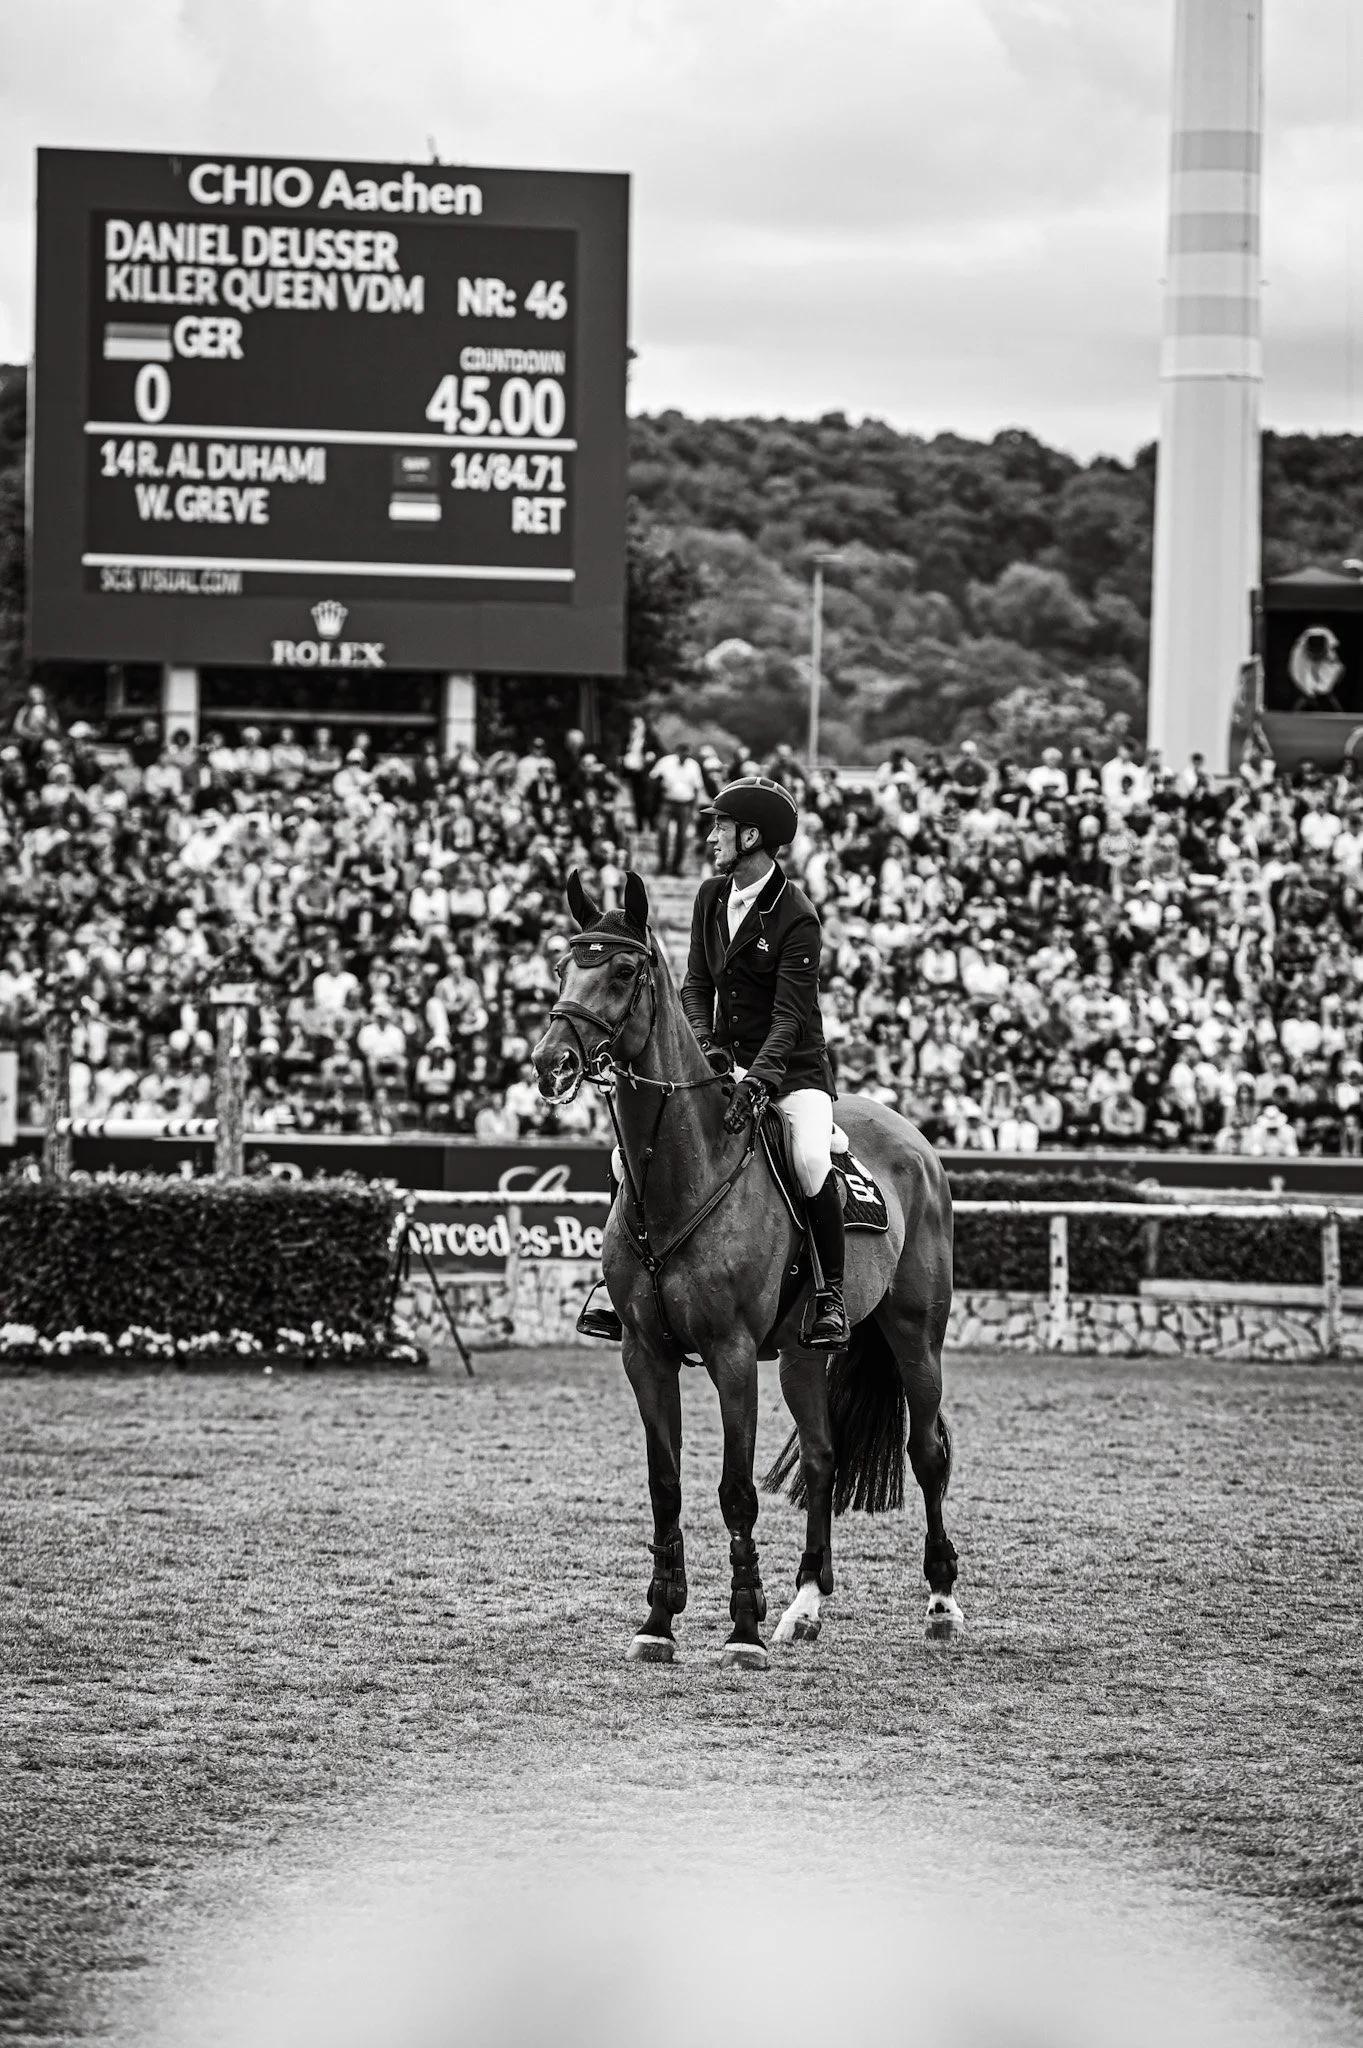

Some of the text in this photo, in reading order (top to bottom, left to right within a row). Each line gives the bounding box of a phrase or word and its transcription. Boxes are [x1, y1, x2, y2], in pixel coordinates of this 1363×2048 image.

[188, 162, 485, 216] CHIO Aachen
[105, 219, 400, 273] DANIEL DEUSSER
[106, 263, 425, 314] KILLER QUEEN VDM
[457, 277, 568, 321] NR: 46
[173, 315, 245, 360] GER
[459, 346, 566, 376] COUNTDOWN
[134, 363, 171, 422] 0
[425, 374, 566, 437] 45.00
[166, 441, 205, 480] AL
[207, 443, 326, 485] DUHAMI
[134, 483, 270, 525] W. GREVE
[511, 496, 567, 534] RET
[271, 640, 387, 668] ROLEX
